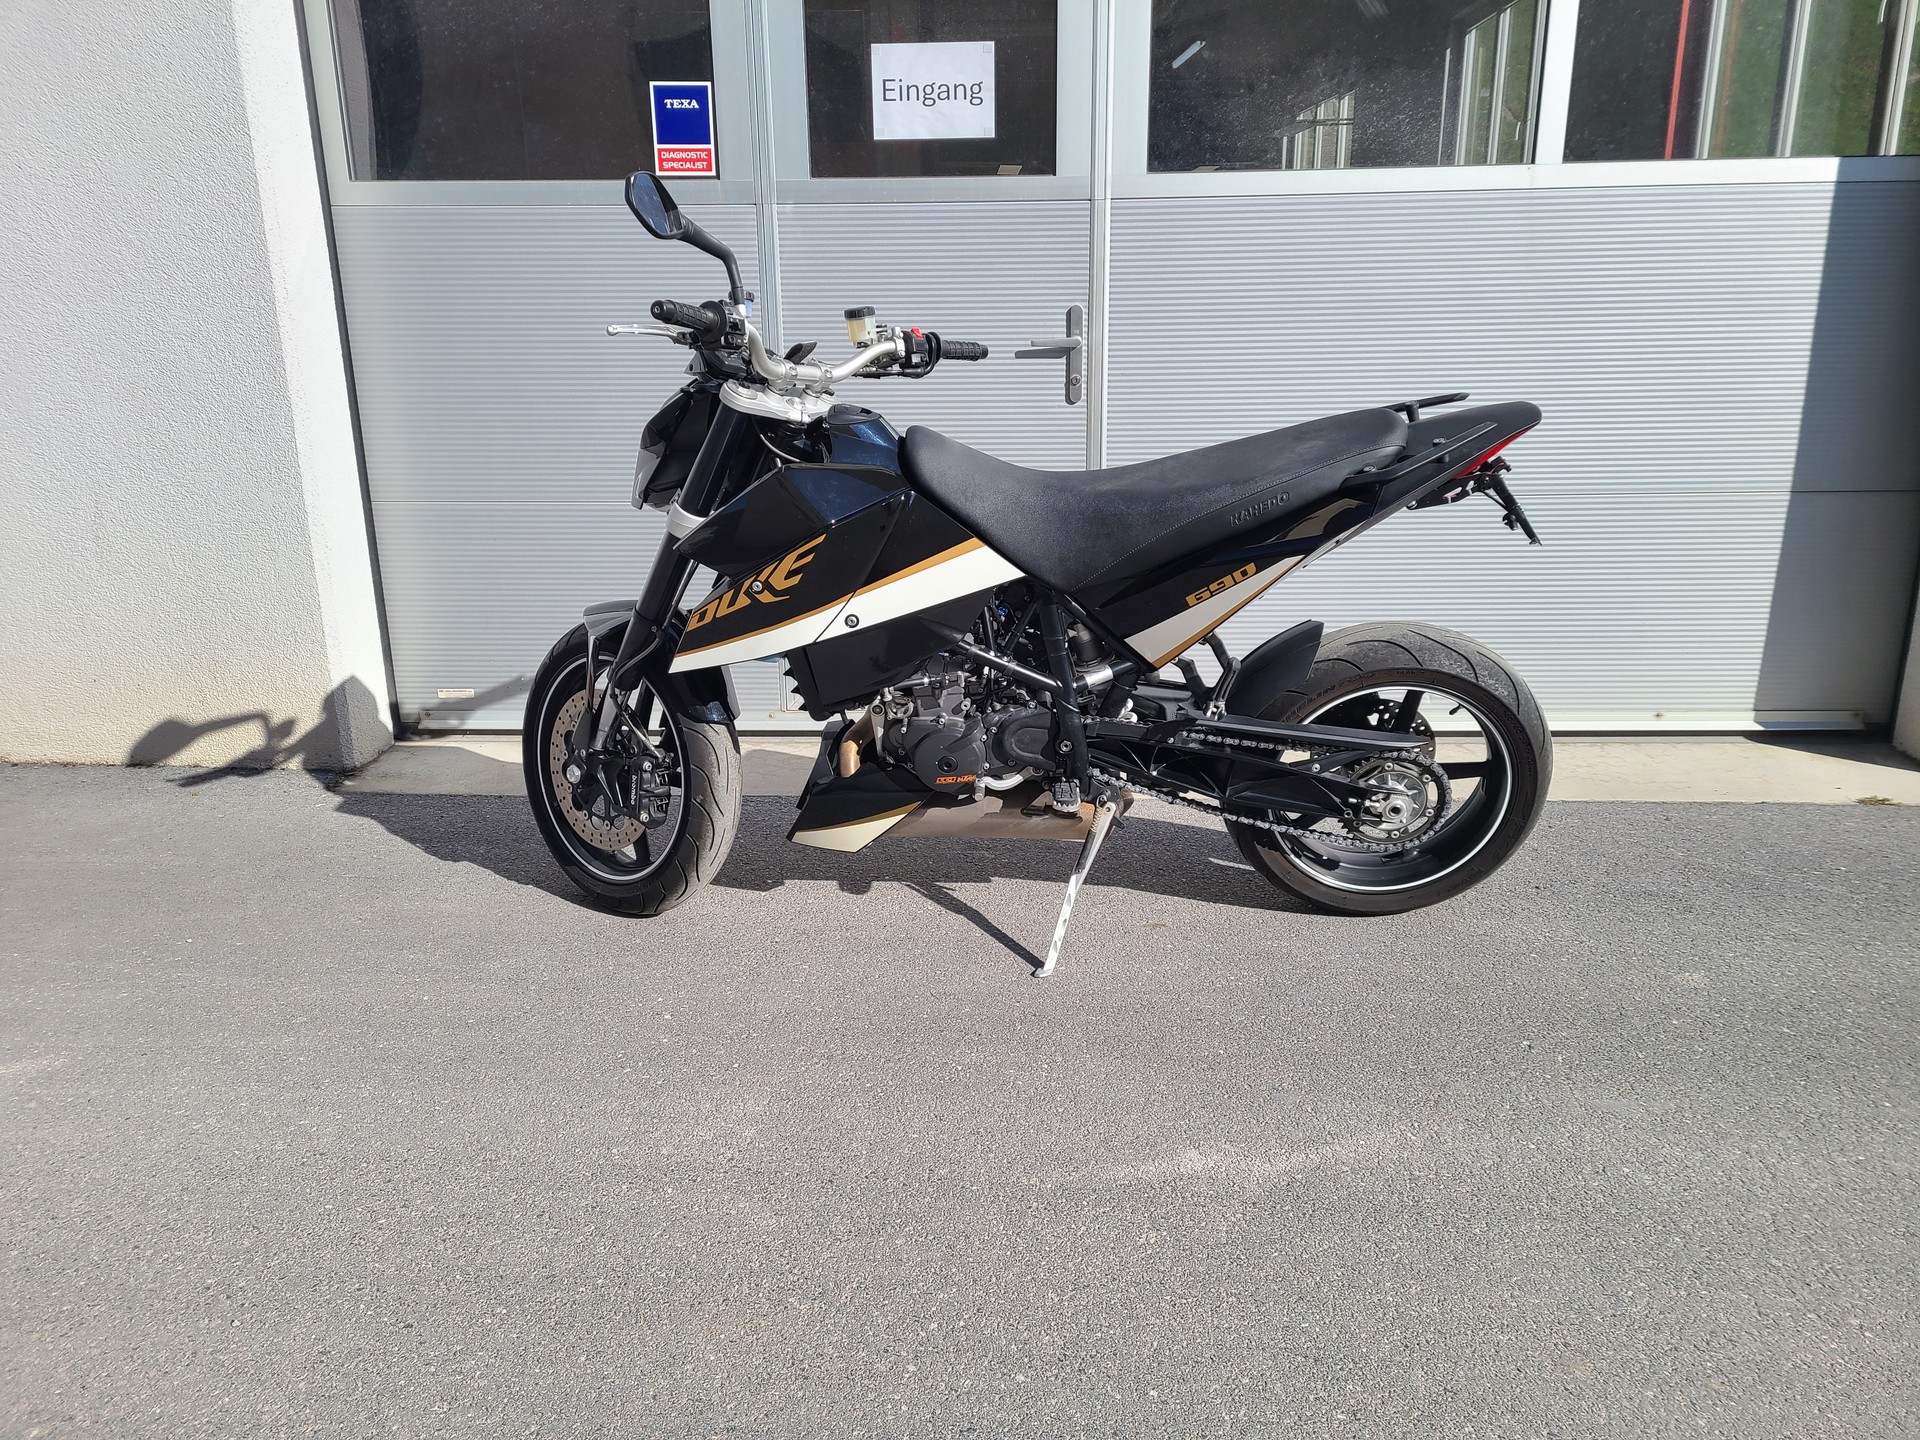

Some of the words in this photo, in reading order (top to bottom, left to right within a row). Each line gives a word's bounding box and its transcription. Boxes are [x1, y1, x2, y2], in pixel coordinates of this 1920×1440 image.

[664, 99, 699, 109] TEXA
[882, 79, 984, 107] Eingang
[661, 151, 708, 159] DIAGNOSTIC
[662, 161, 708, 169] SPECIALIST
[1230, 491, 1290, 527] KAHEDO
[686, 533, 827, 632] DUKE
[1185, 562, 1257, 607] 690
